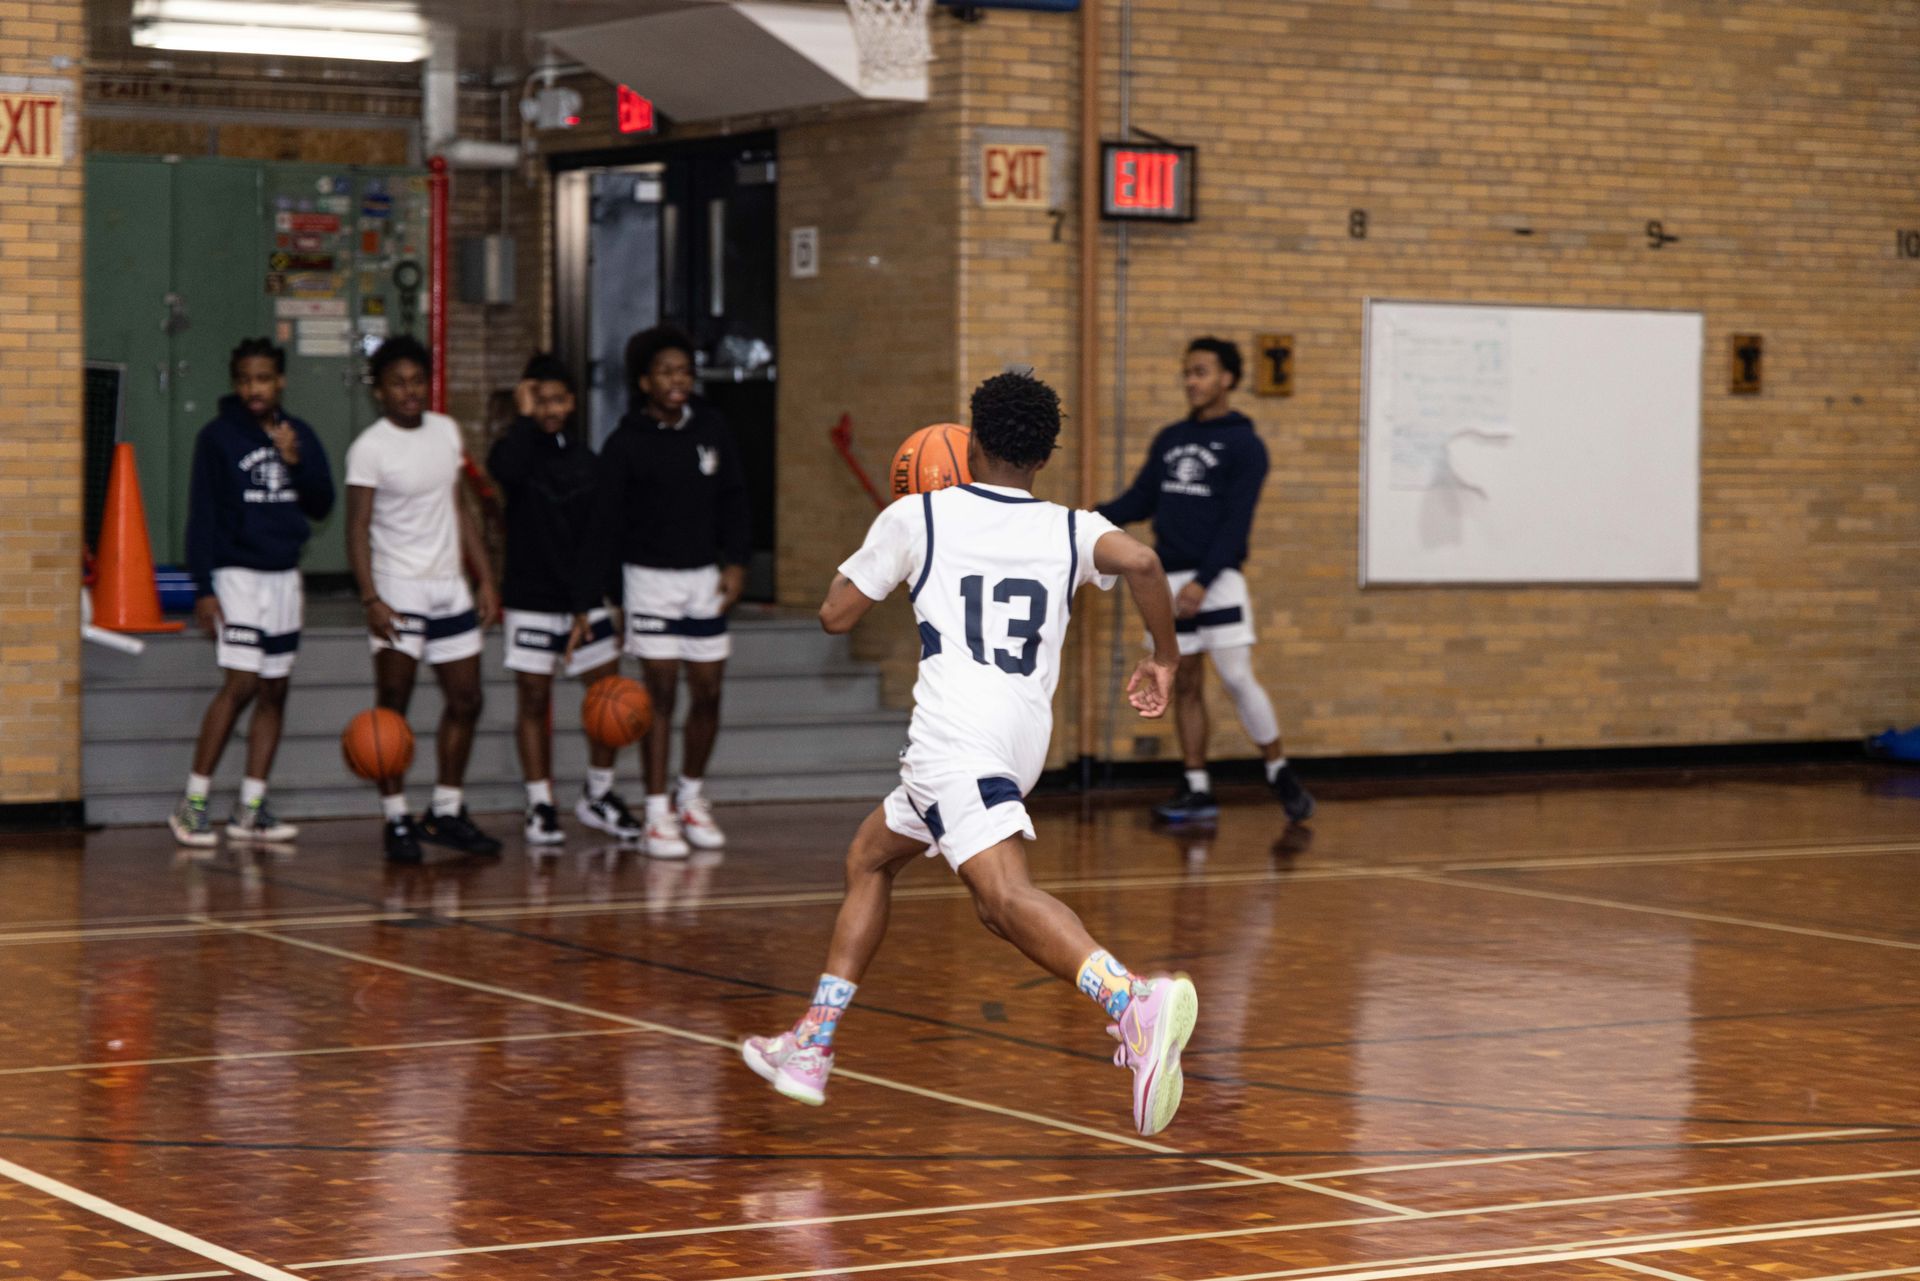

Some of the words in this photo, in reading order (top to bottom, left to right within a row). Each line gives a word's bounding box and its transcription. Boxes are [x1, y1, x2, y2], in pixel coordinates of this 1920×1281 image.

[0, 98, 56, 155] XIT
[984, 148, 1046, 201] EXIT
[1114, 150, 1177, 208] EXIT
[1047, 209, 1066, 243] 7
[1350, 208, 1367, 240] 8
[959, 574, 1048, 677] 13
